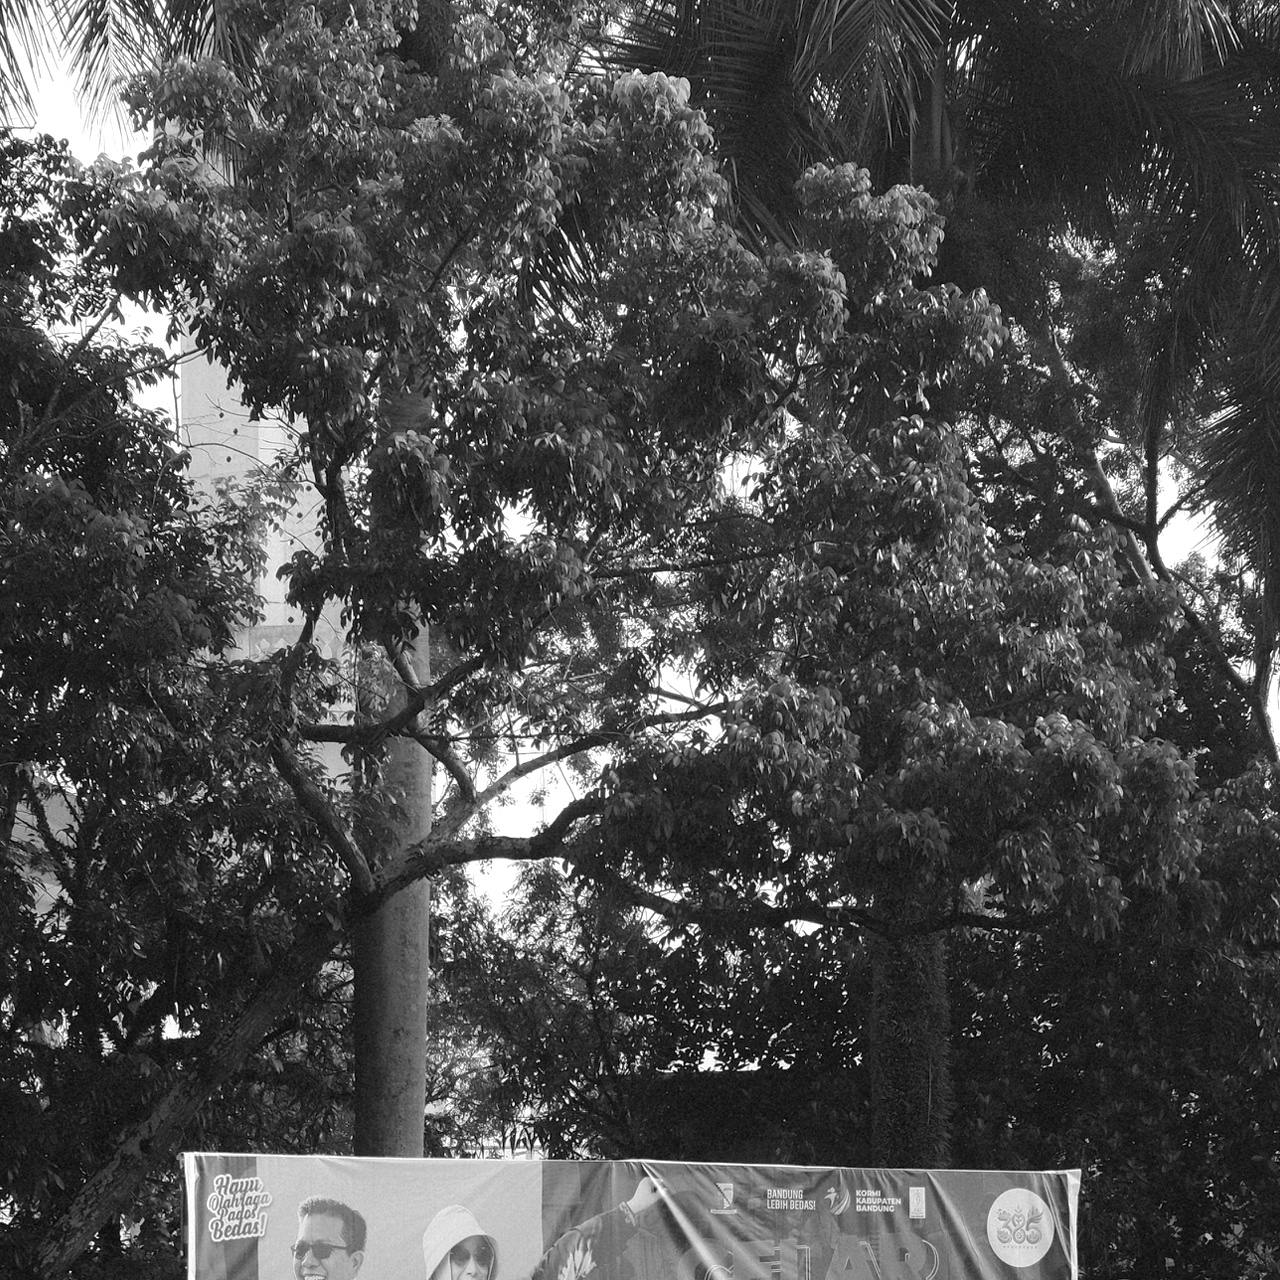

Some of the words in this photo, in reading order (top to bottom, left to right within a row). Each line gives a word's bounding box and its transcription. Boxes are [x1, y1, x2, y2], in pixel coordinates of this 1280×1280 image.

[766, 1188, 804, 1200] BANDUNG
[855, 1189, 881, 1198] KORMI
[766, 1199, 788, 1210] LEBIH
[789, 1200, 816, 1211] BEDAS!
[855, 1197, 902, 1205] KABUPATEN
[855, 1204, 895, 1213] BANDUNG
